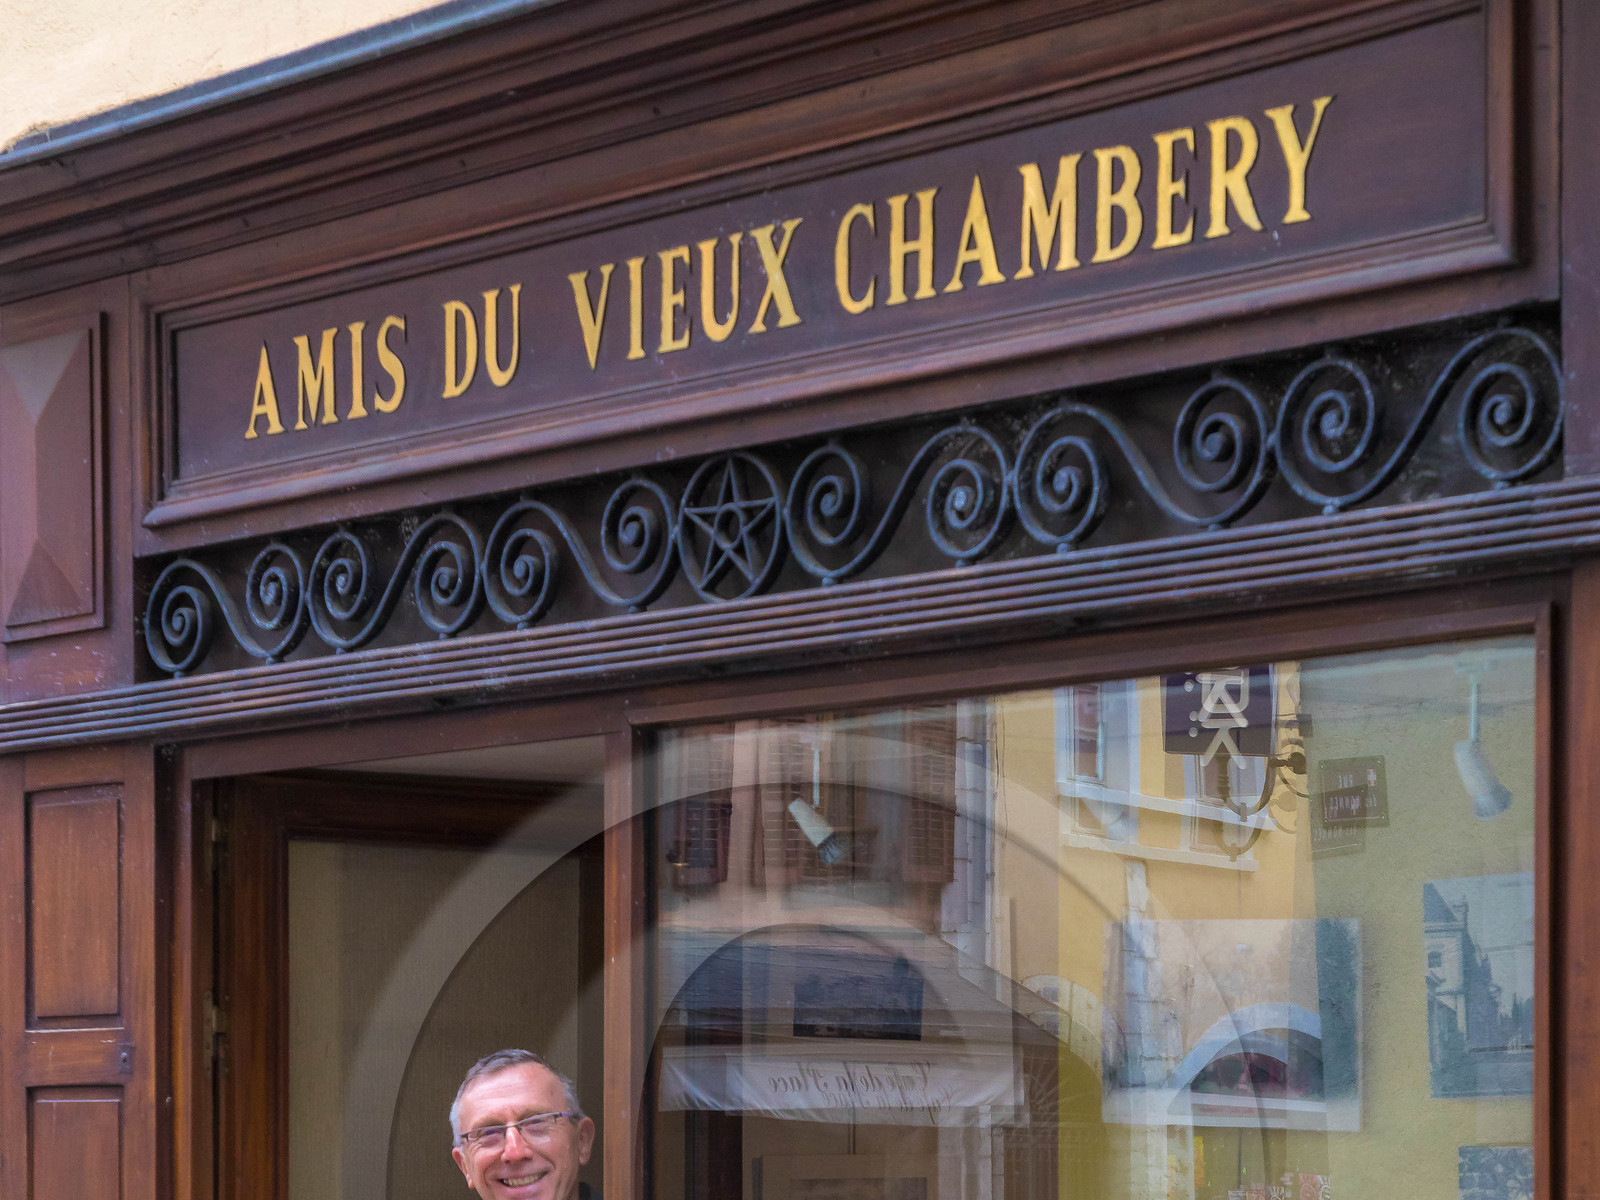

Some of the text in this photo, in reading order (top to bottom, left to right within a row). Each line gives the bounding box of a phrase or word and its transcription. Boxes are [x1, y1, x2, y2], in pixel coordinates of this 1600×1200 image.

[243, 94, 1335, 439] AMIS DU VIEUX CHAMBERY
